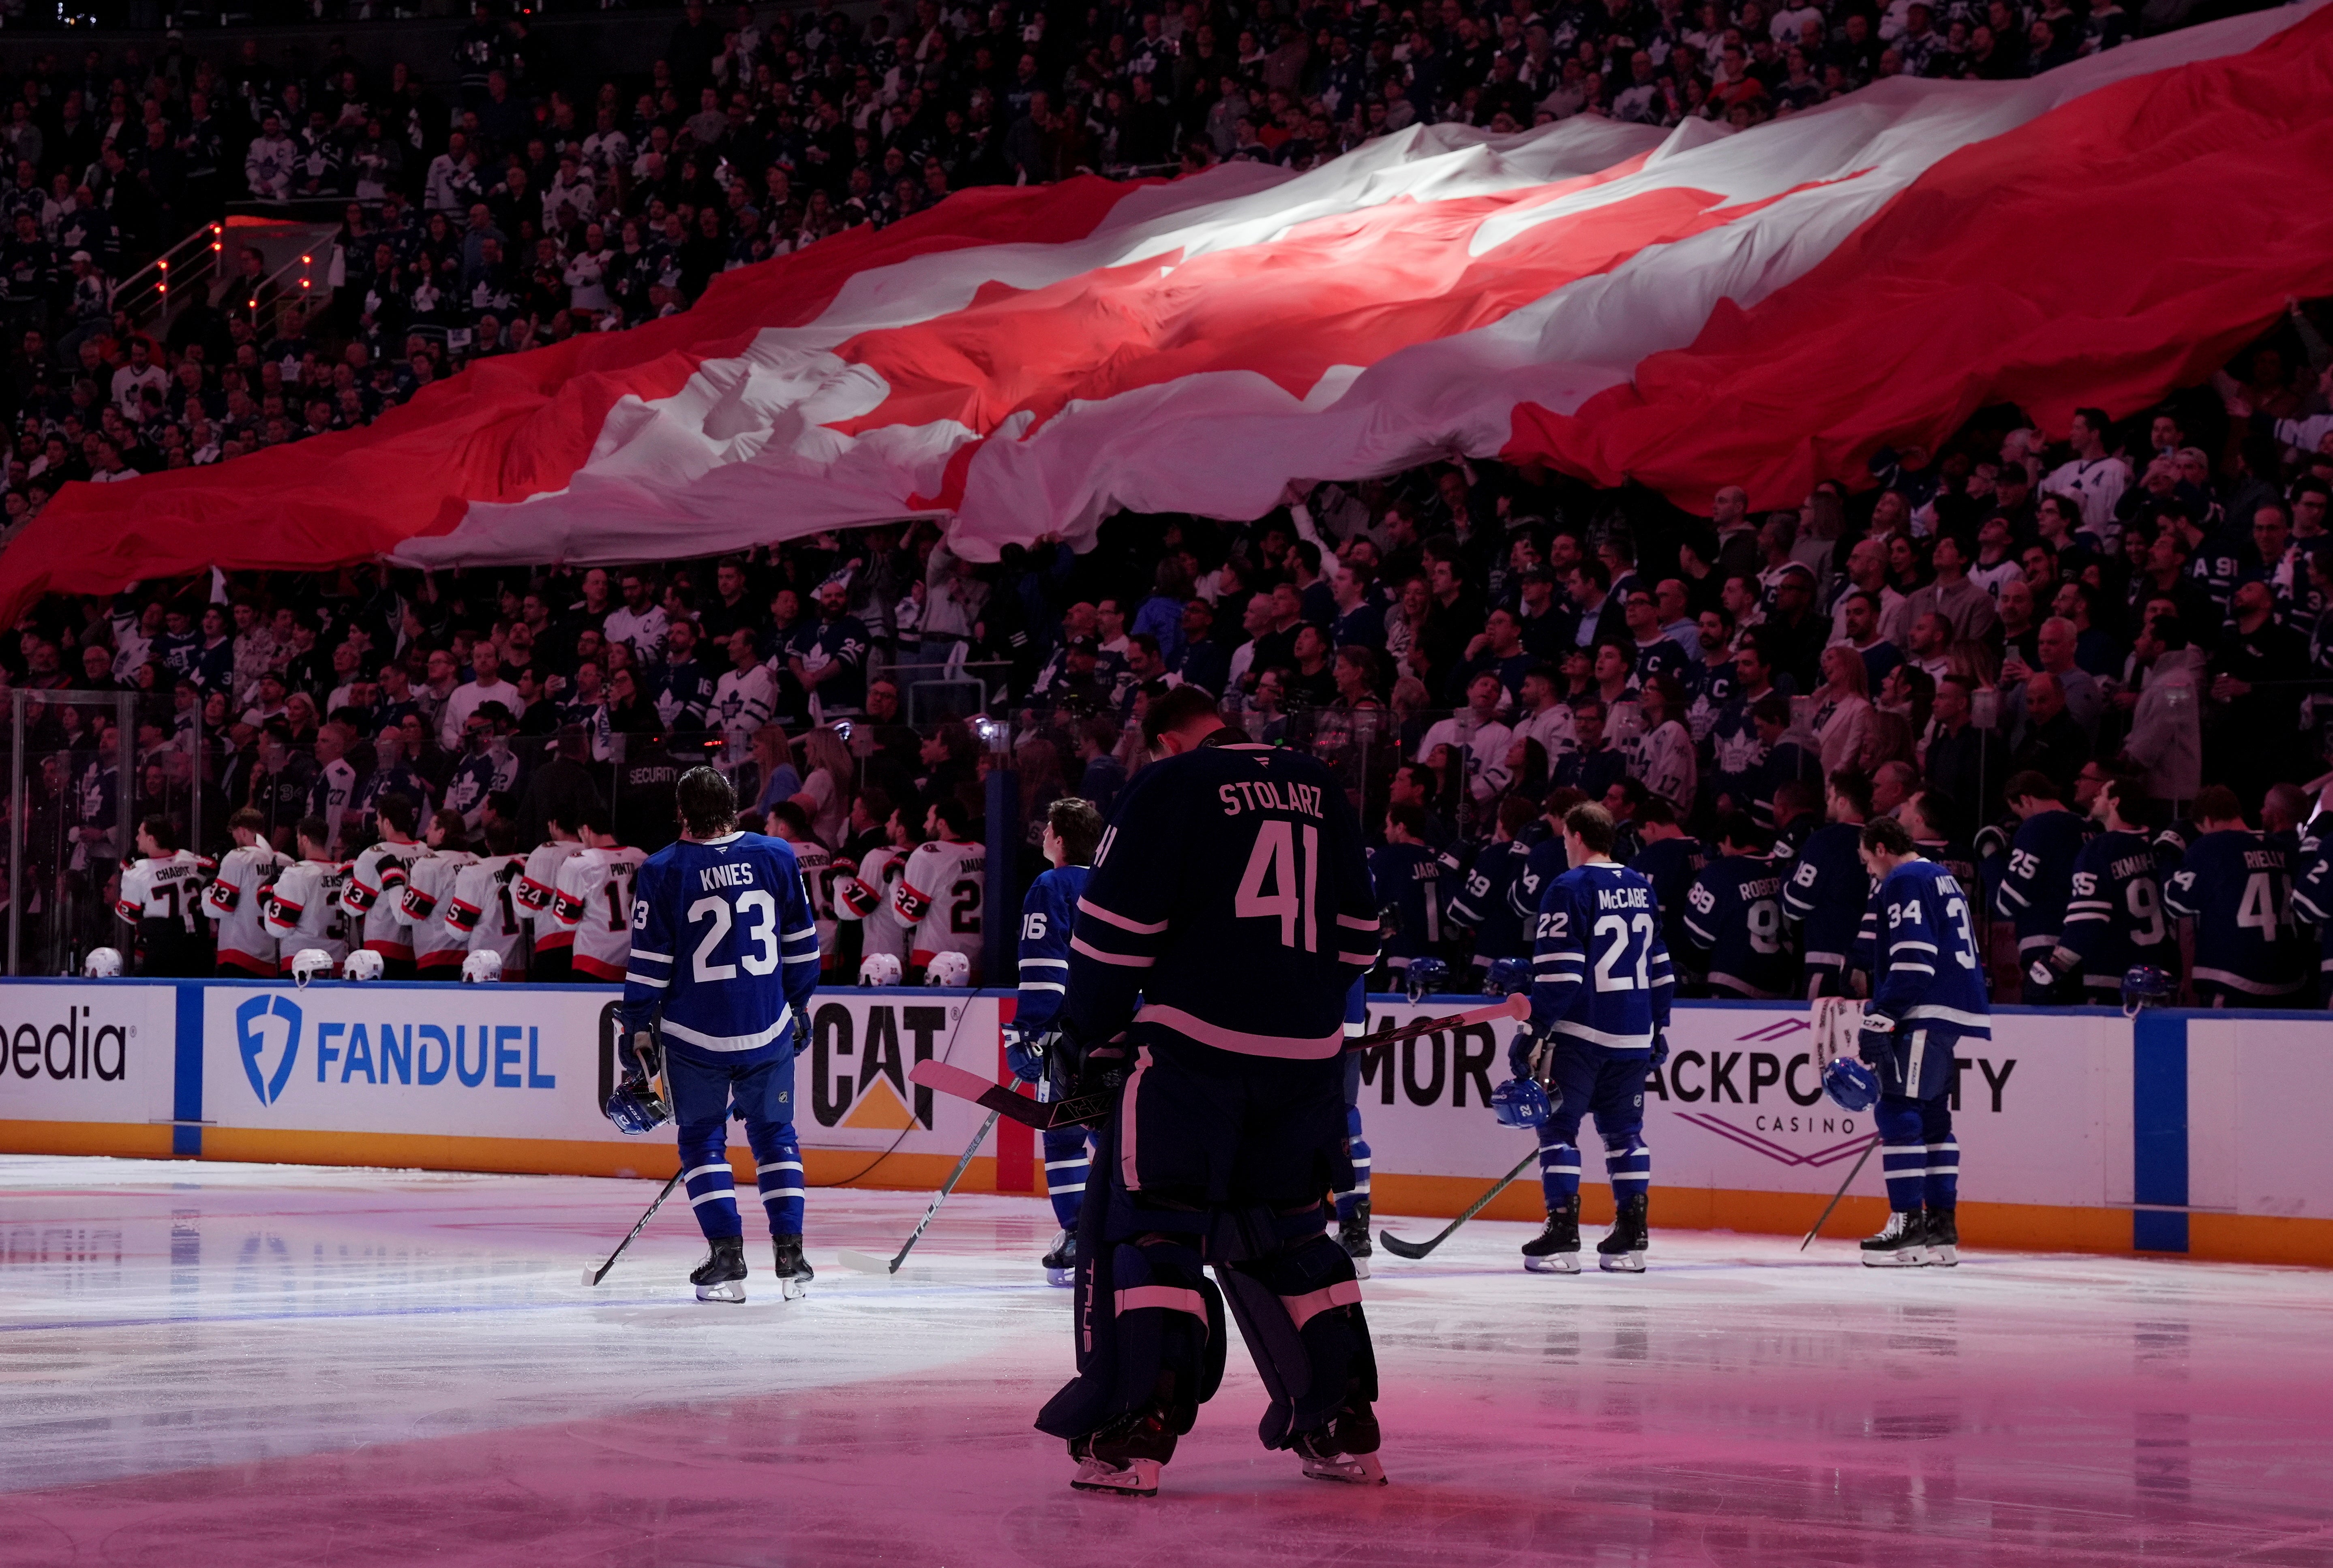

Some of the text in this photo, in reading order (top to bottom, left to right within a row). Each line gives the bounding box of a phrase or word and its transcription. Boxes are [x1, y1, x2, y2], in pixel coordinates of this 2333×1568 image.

[2193, 557, 2209, 578] A
[1647, 655, 1658, 672] C
[1713, 678, 1729, 698] C
[629, 766, 678, 785] SECURITY
[1219, 781, 1324, 819] STOLARZ
[156, 866, 189, 881] CHABOT
[2008, 848, 2041, 880] 25
[2243, 851, 2286, 869] RIELLY
[699, 863, 754, 891] KNIES
[1235, 820, 1318, 953] 41
[517, 883, 542, 905] 24
[555, 898, 567, 916] 2
[951, 879, 980, 933] 2
[1598, 888, 1650, 909] McCABE
[447, 903, 461, 921] 5
[498, 886, 521, 936] 1
[633, 896, 649, 930] 3
[1021, 913, 1048, 941] 16
[1424, 881, 1439, 942] 1
[1536, 912, 1568, 939] 22
[1887, 899, 1922, 929] 34
[2125, 877, 2166, 946] 9
[688, 890, 778, 983] 23
[1946, 897, 1980, 969] 3
[1594, 913, 1654, 993] 22
[0, 1006, 125, 1081] edia
[317, 1023, 555, 1089] FANDUEL
[812, 1002, 945, 1131] CAT
[1360, 1016, 1499, 1108] MOR
[1644, 1050, 1823, 1106] ACKPO
[1951, 1058, 2017, 1112] TY
[627, 1105, 642, 1121] CCM
[1757, 1115, 1854, 1134] CASINO
[910, 1190, 945, 1238] TRUE
[1082, 1258, 1095, 1353] TRUE
